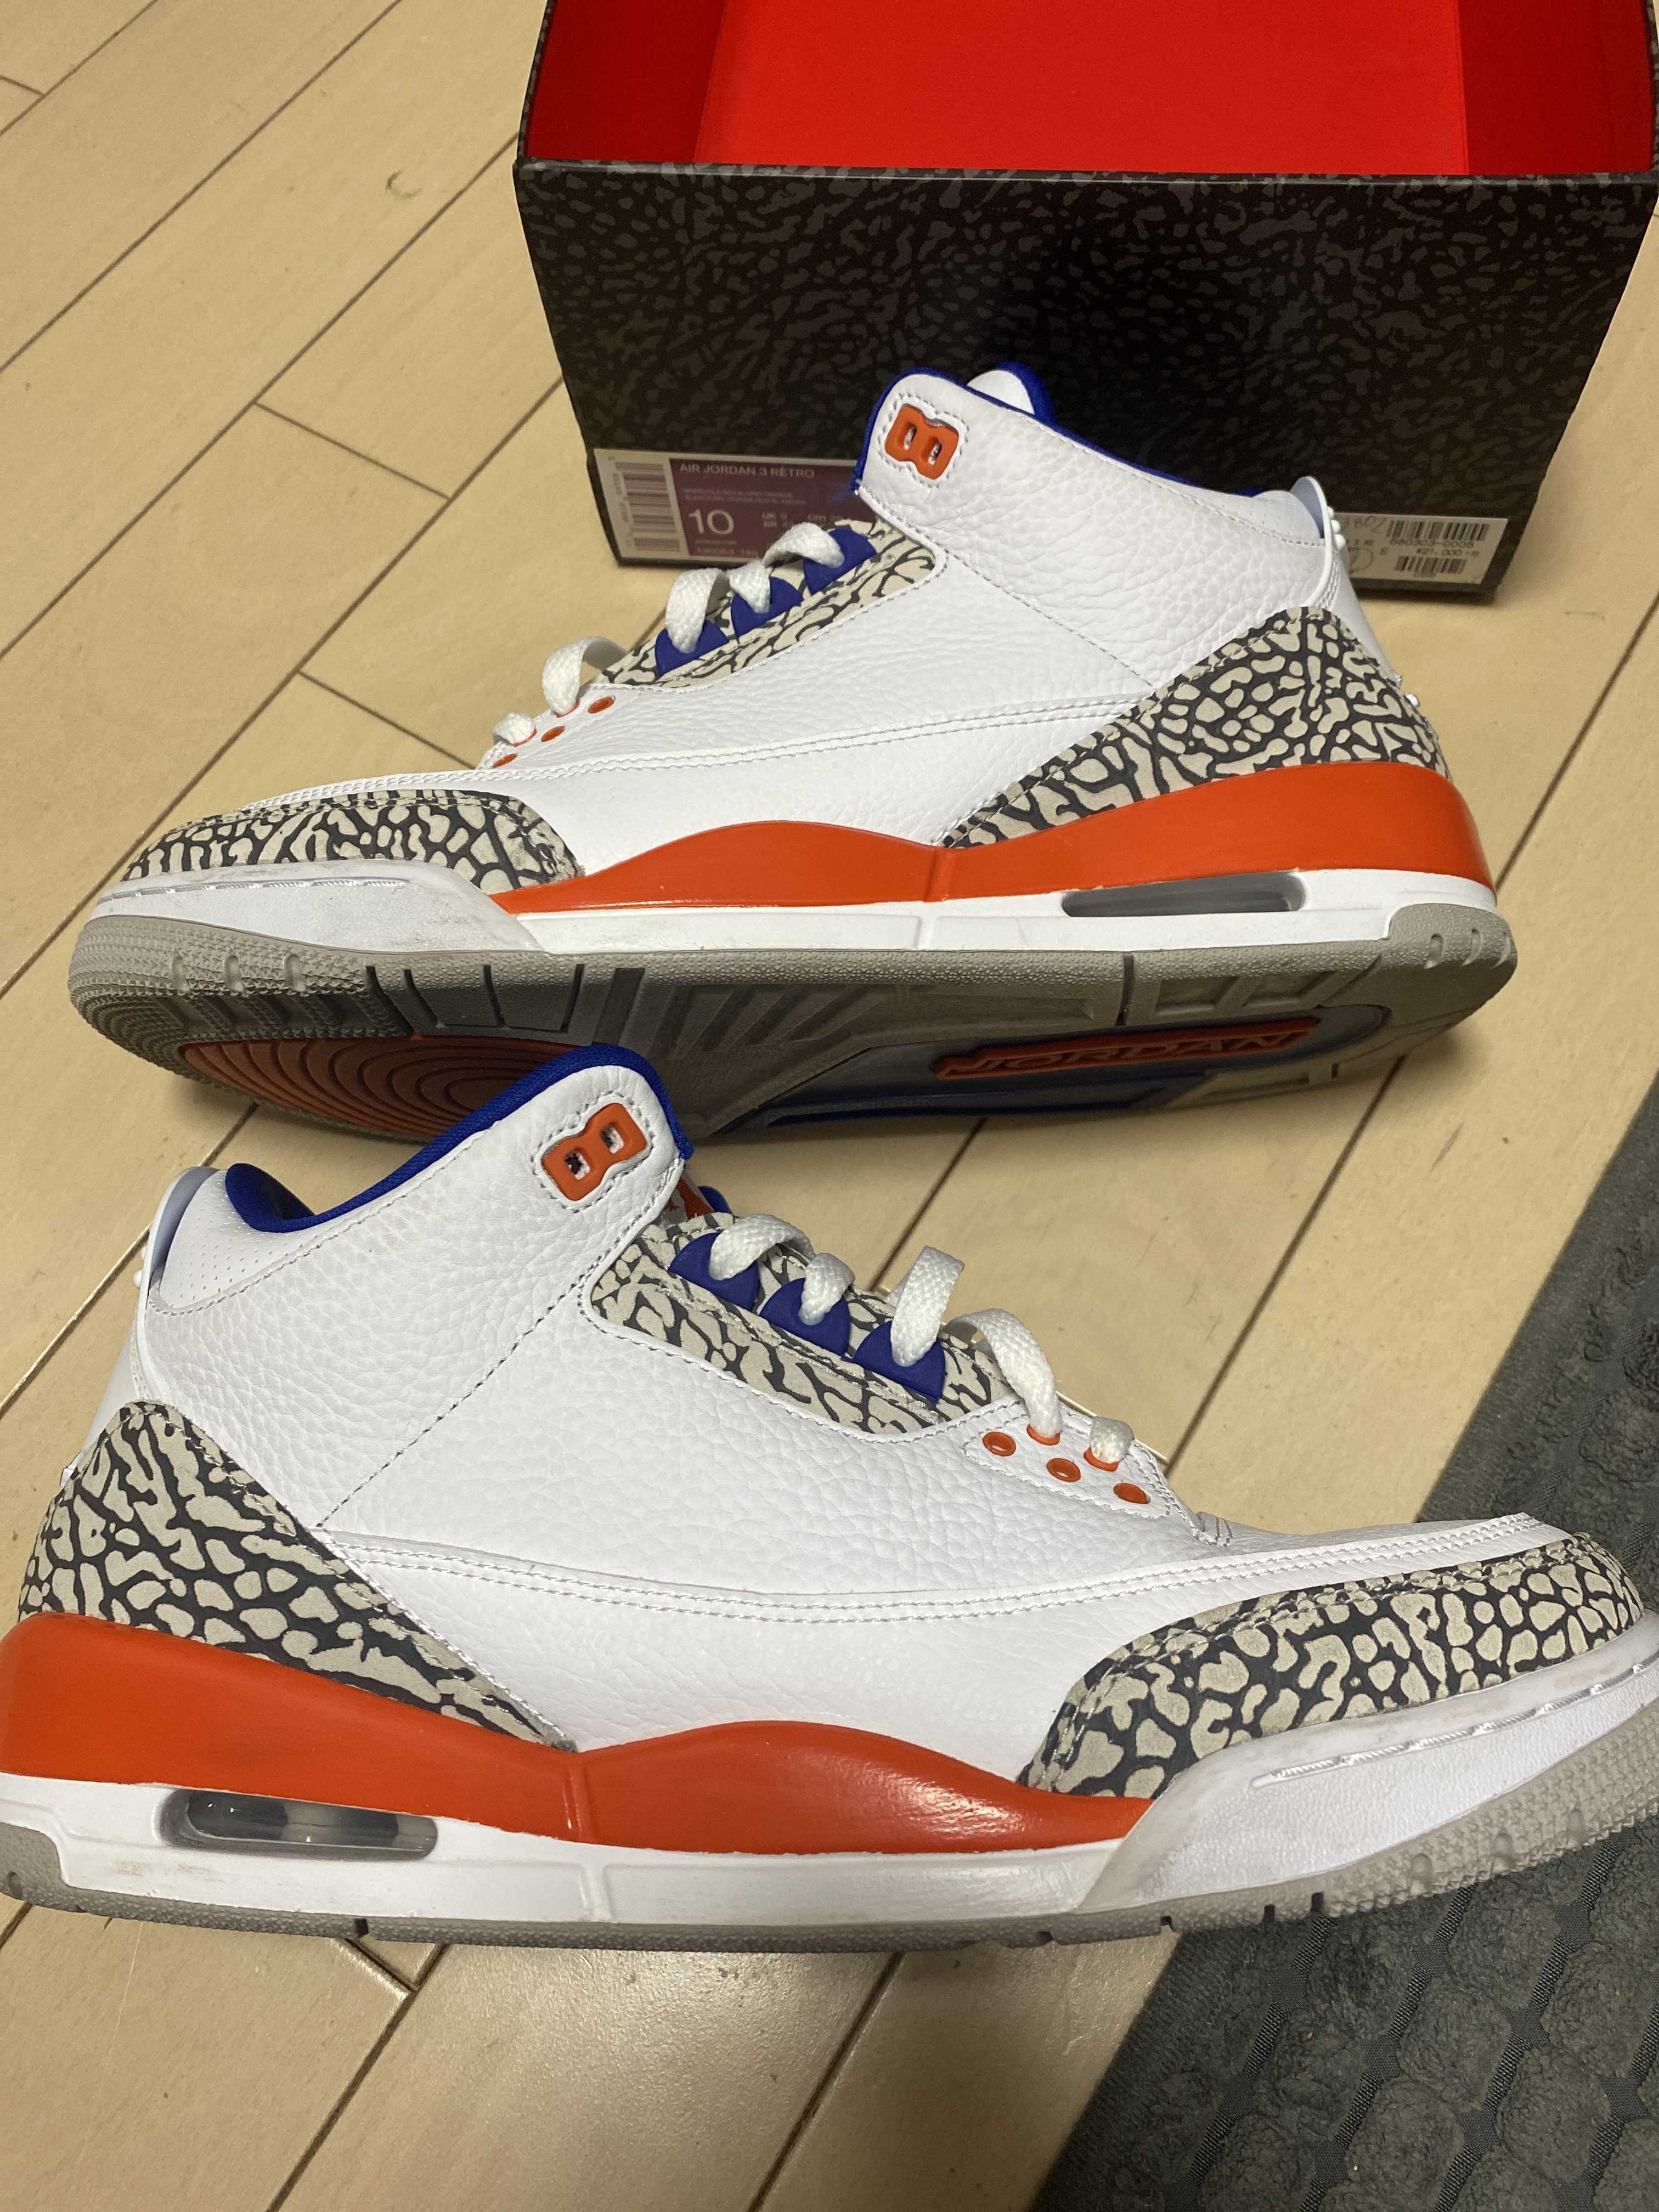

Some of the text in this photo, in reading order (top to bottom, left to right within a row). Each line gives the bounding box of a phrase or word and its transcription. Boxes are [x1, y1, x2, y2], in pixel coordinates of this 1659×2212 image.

[680, 464, 701, 475] AIR
[703, 465, 756, 476] JORDAN
[759, 467, 768, 476] 3
[688, 509, 735, 535] 10
